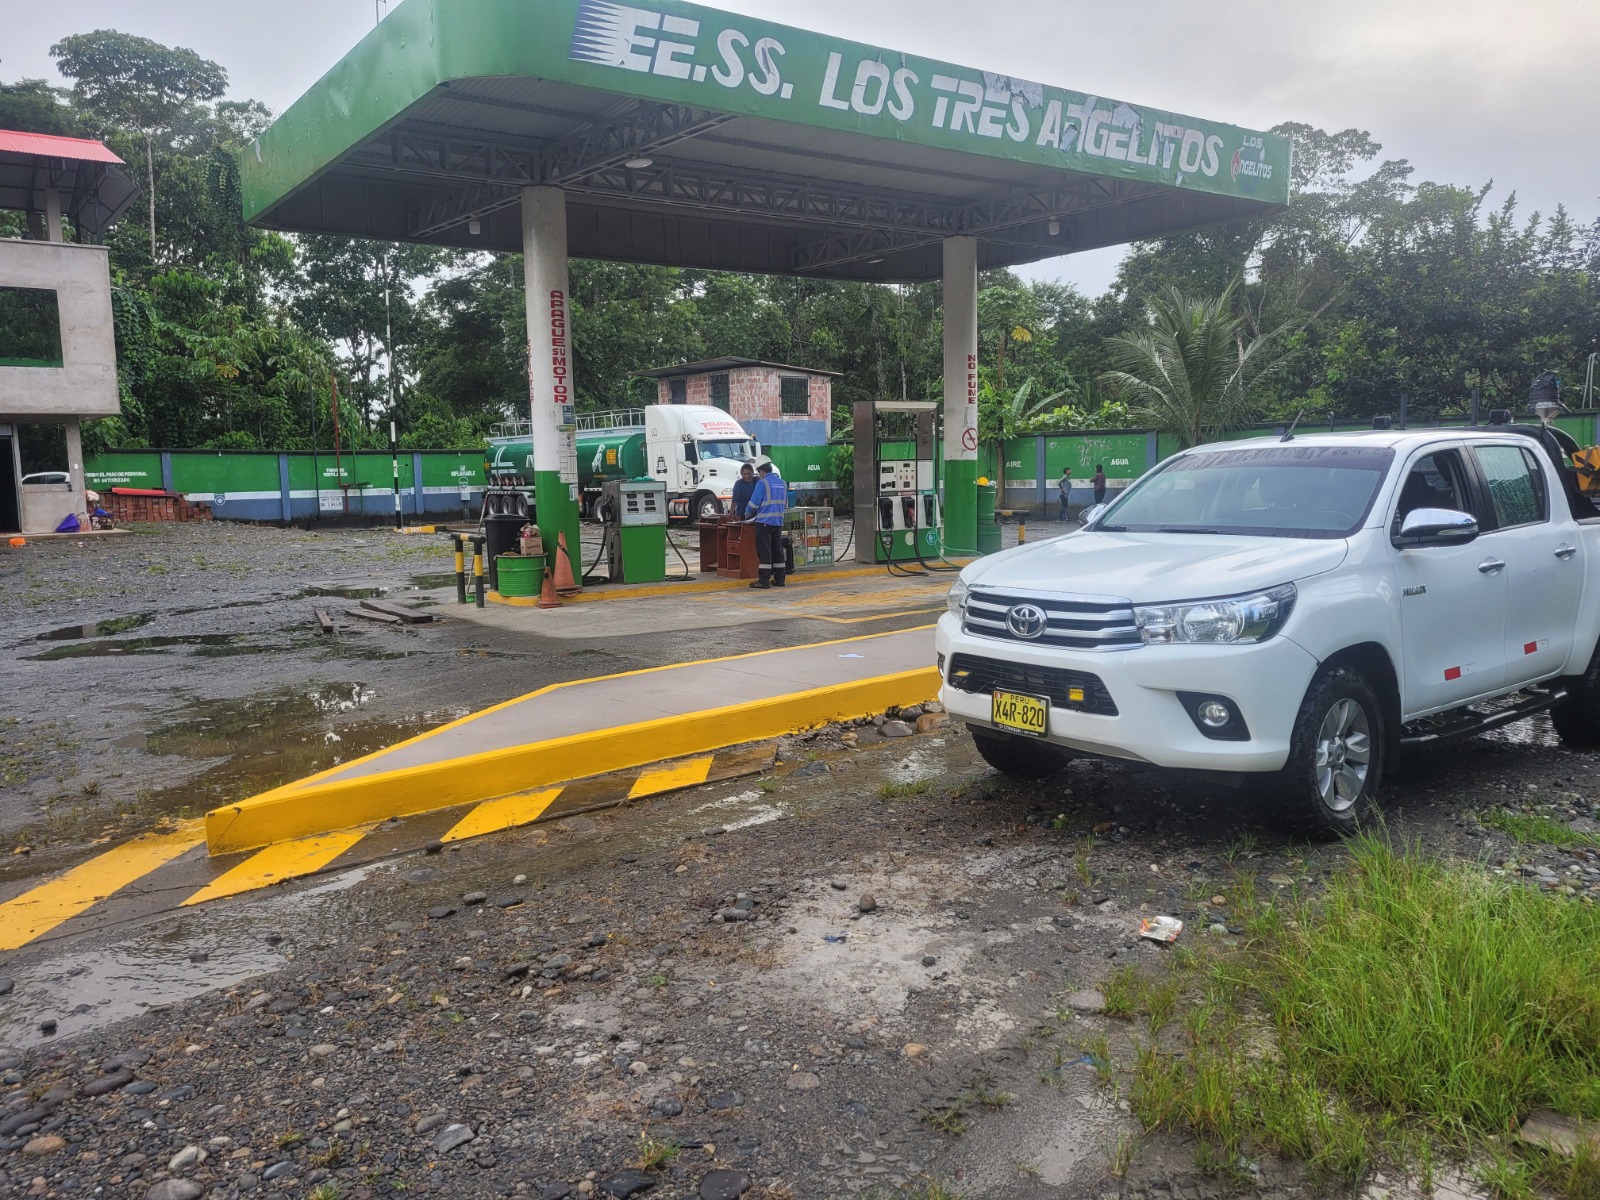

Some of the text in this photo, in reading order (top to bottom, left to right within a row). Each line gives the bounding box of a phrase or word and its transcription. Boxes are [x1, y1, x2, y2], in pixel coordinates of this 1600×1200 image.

[818, 51, 920, 121] LOS
[931, 73, 1031, 143] TRES
[1035, 98, 1225, 178] ANGELITOS
[1242, 135, 1264, 149] LOS
[550, 289, 566, 347] APAGUE
[552, 347, 566, 356] SU
[967, 354, 976, 370] NO
[552, 356, 568, 404] MOTOR
[967, 373, 976, 405] FUME
[1005, 460, 1022, 468] AIRE
[1110, 458, 1129, 466] AGUA
[1010, 694, 1030, 705] PERU
[995, 699, 1044, 727] X4R-820
